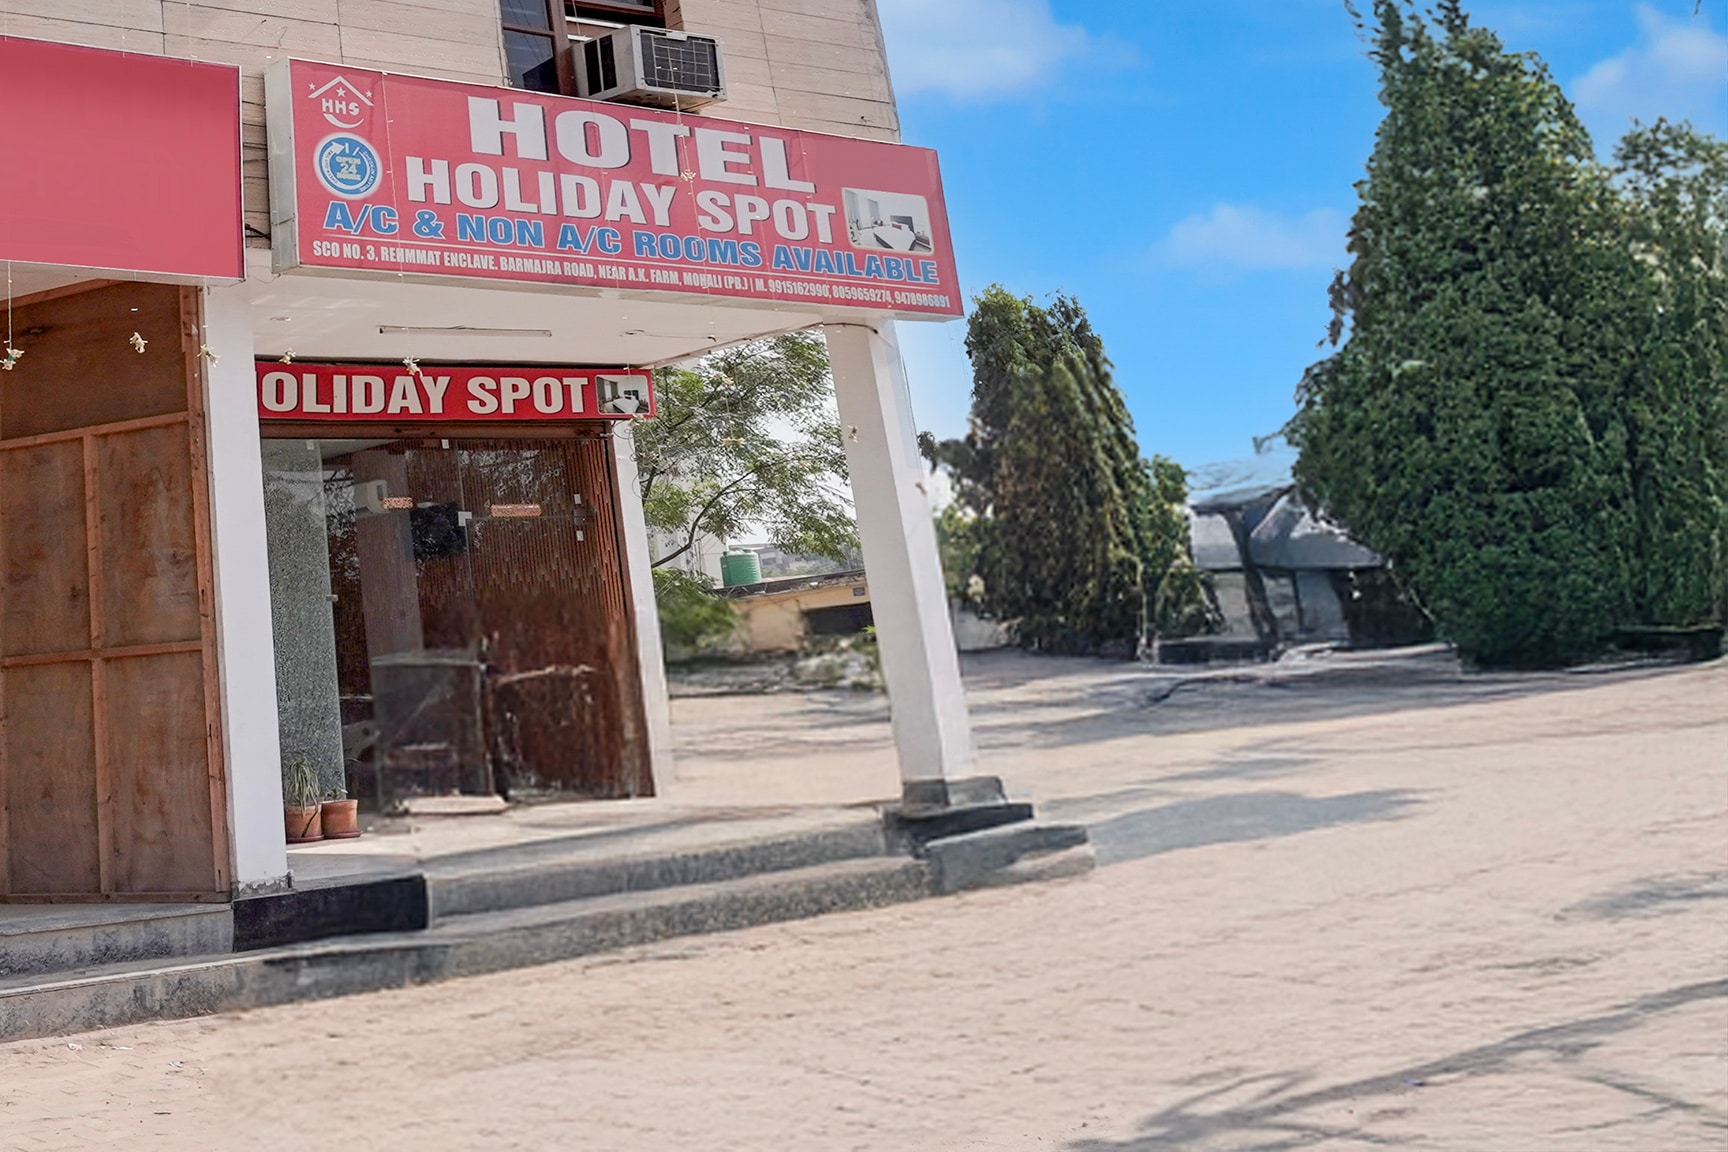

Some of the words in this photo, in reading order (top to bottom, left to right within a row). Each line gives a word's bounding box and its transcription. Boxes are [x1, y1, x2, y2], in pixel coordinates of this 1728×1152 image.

[322, 97, 360, 116] HHS
[340, 161, 358, 174] 24
[467, 96, 816, 194] HOTEL
[405, 156, 677, 227] HOLIDAY
[696, 190, 836, 244] SPOT
[312, 240, 340, 257] SCO
[343, 243, 364, 259] NO.
[366, 245, 378, 261] 3,
[499, 256, 562, 275] BARMAJRA
[564, 262, 597, 279] ROAD,
[598, 264, 626, 280] NEAR
[628, 268, 649, 282] A.K.
[650, 269, 682, 286] FARM,
[683, 272, 722, 288] MOHALI
[723, 275, 748, 290] (PB.)
[755, 278, 767, 292] M.
[323, 201, 399, 235] A/C
[412, 209, 446, 240] &
[455, 212, 545, 248] NON
[557, 223, 622, 255] A/C
[632, 230, 763, 268] ROOMS
[772, 245, 940, 285] AVAILABLE
[261, 371, 451, 414] OLIDAY
[467, 376, 589, 414] SPOT
